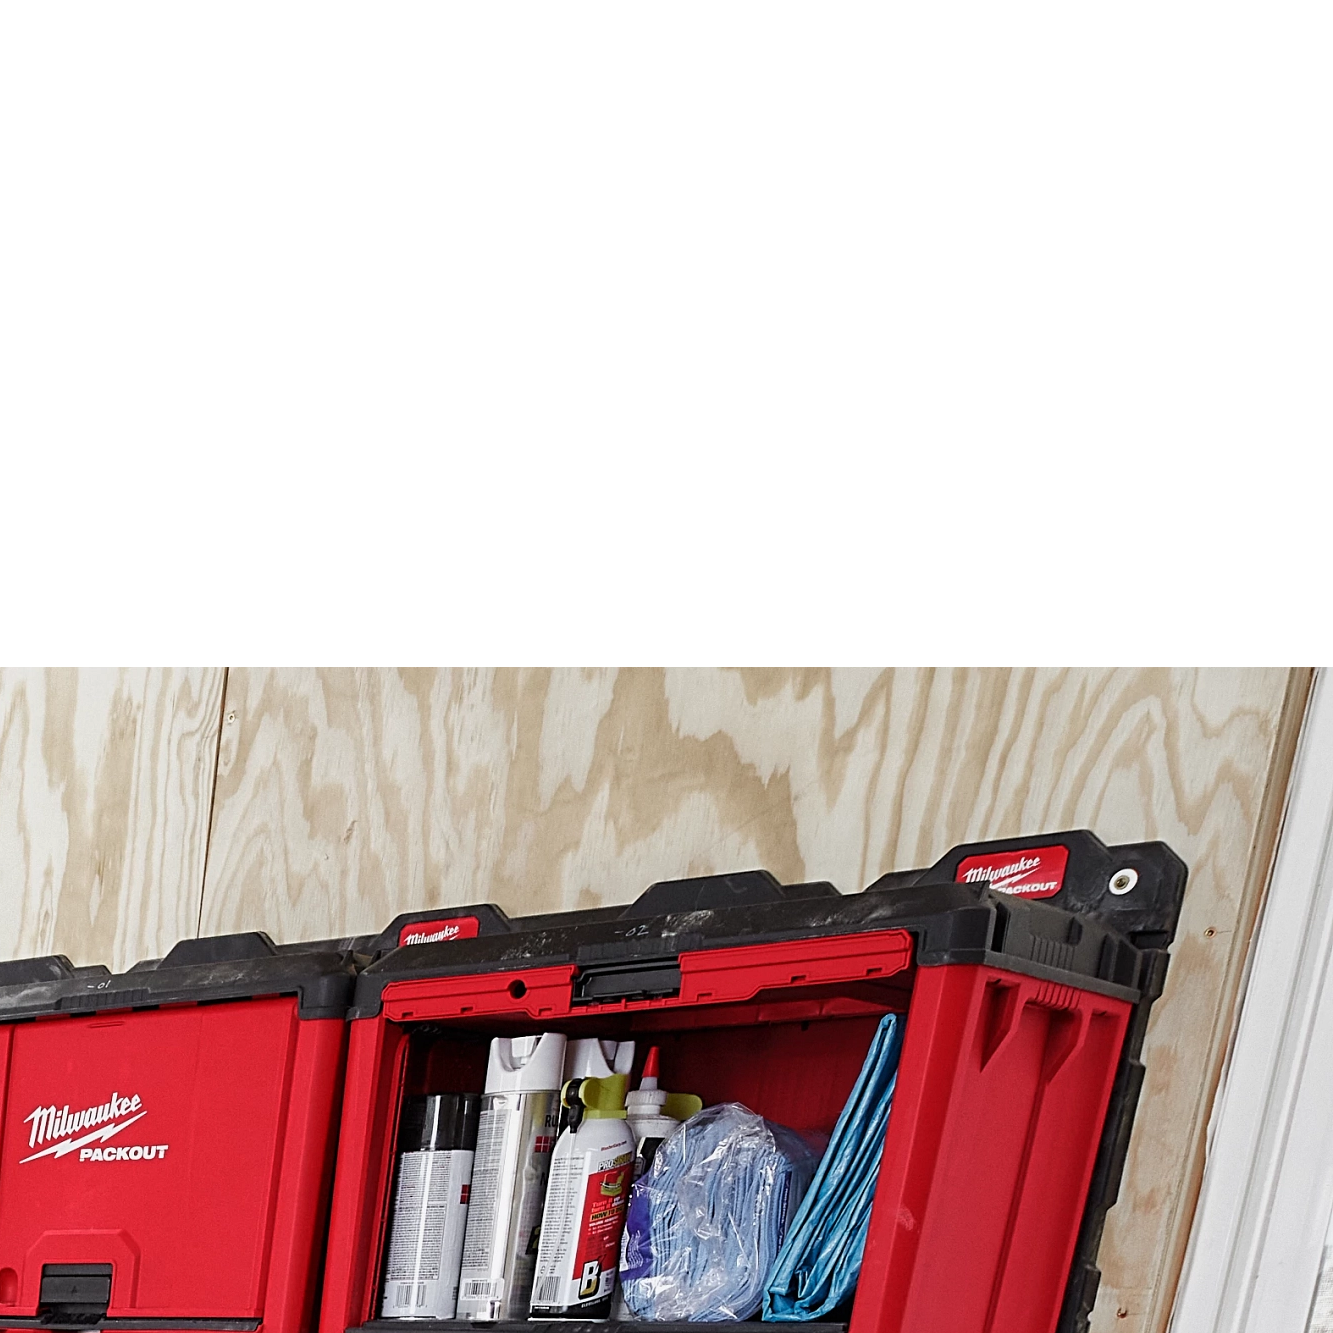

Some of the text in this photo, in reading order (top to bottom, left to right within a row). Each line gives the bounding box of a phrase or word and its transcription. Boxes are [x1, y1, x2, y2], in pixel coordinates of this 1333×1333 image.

[962, 856, 1040, 884] Milwaukee
[403, 925, 460, 946] Milwaukee
[22, 1092, 144, 1149] Milwaukee
[79, 1144, 169, 1162] PACKOUT
